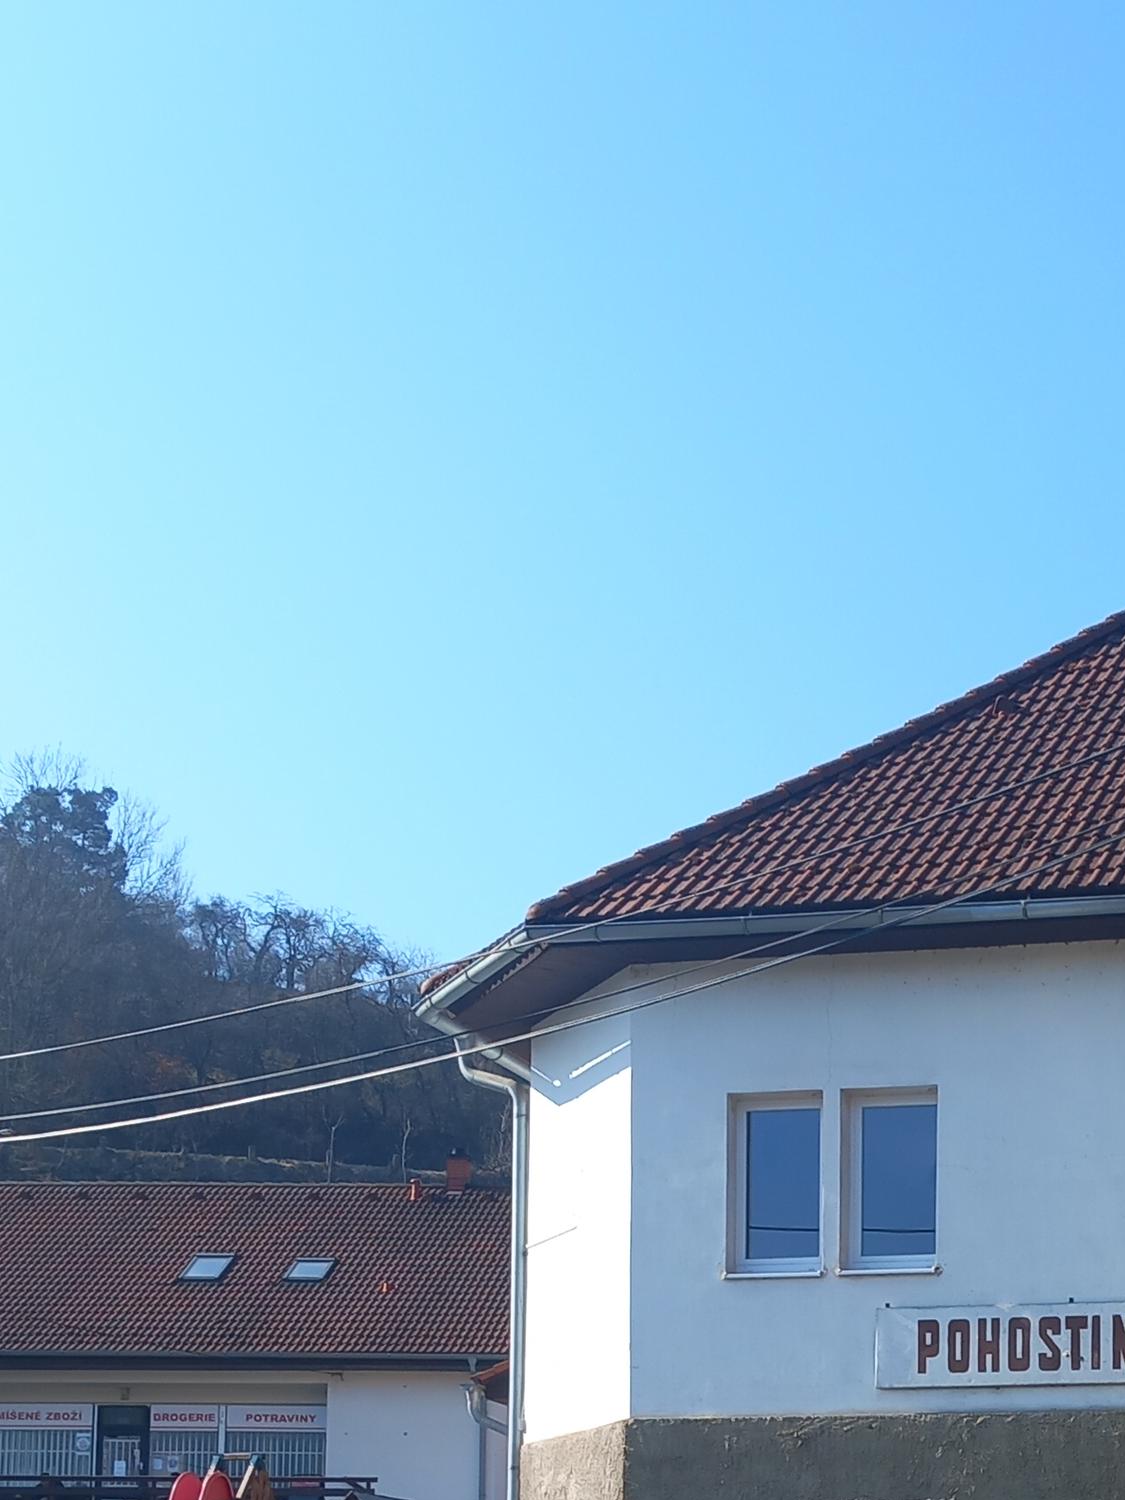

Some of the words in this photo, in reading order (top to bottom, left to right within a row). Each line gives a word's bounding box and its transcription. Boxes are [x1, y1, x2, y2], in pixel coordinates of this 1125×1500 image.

[46, 1410, 82, 1421] ZBOŽÍ
[153, 1413, 216, 1422] DROGERIE
[245, 1413, 317, 1423] POTRAVINY
